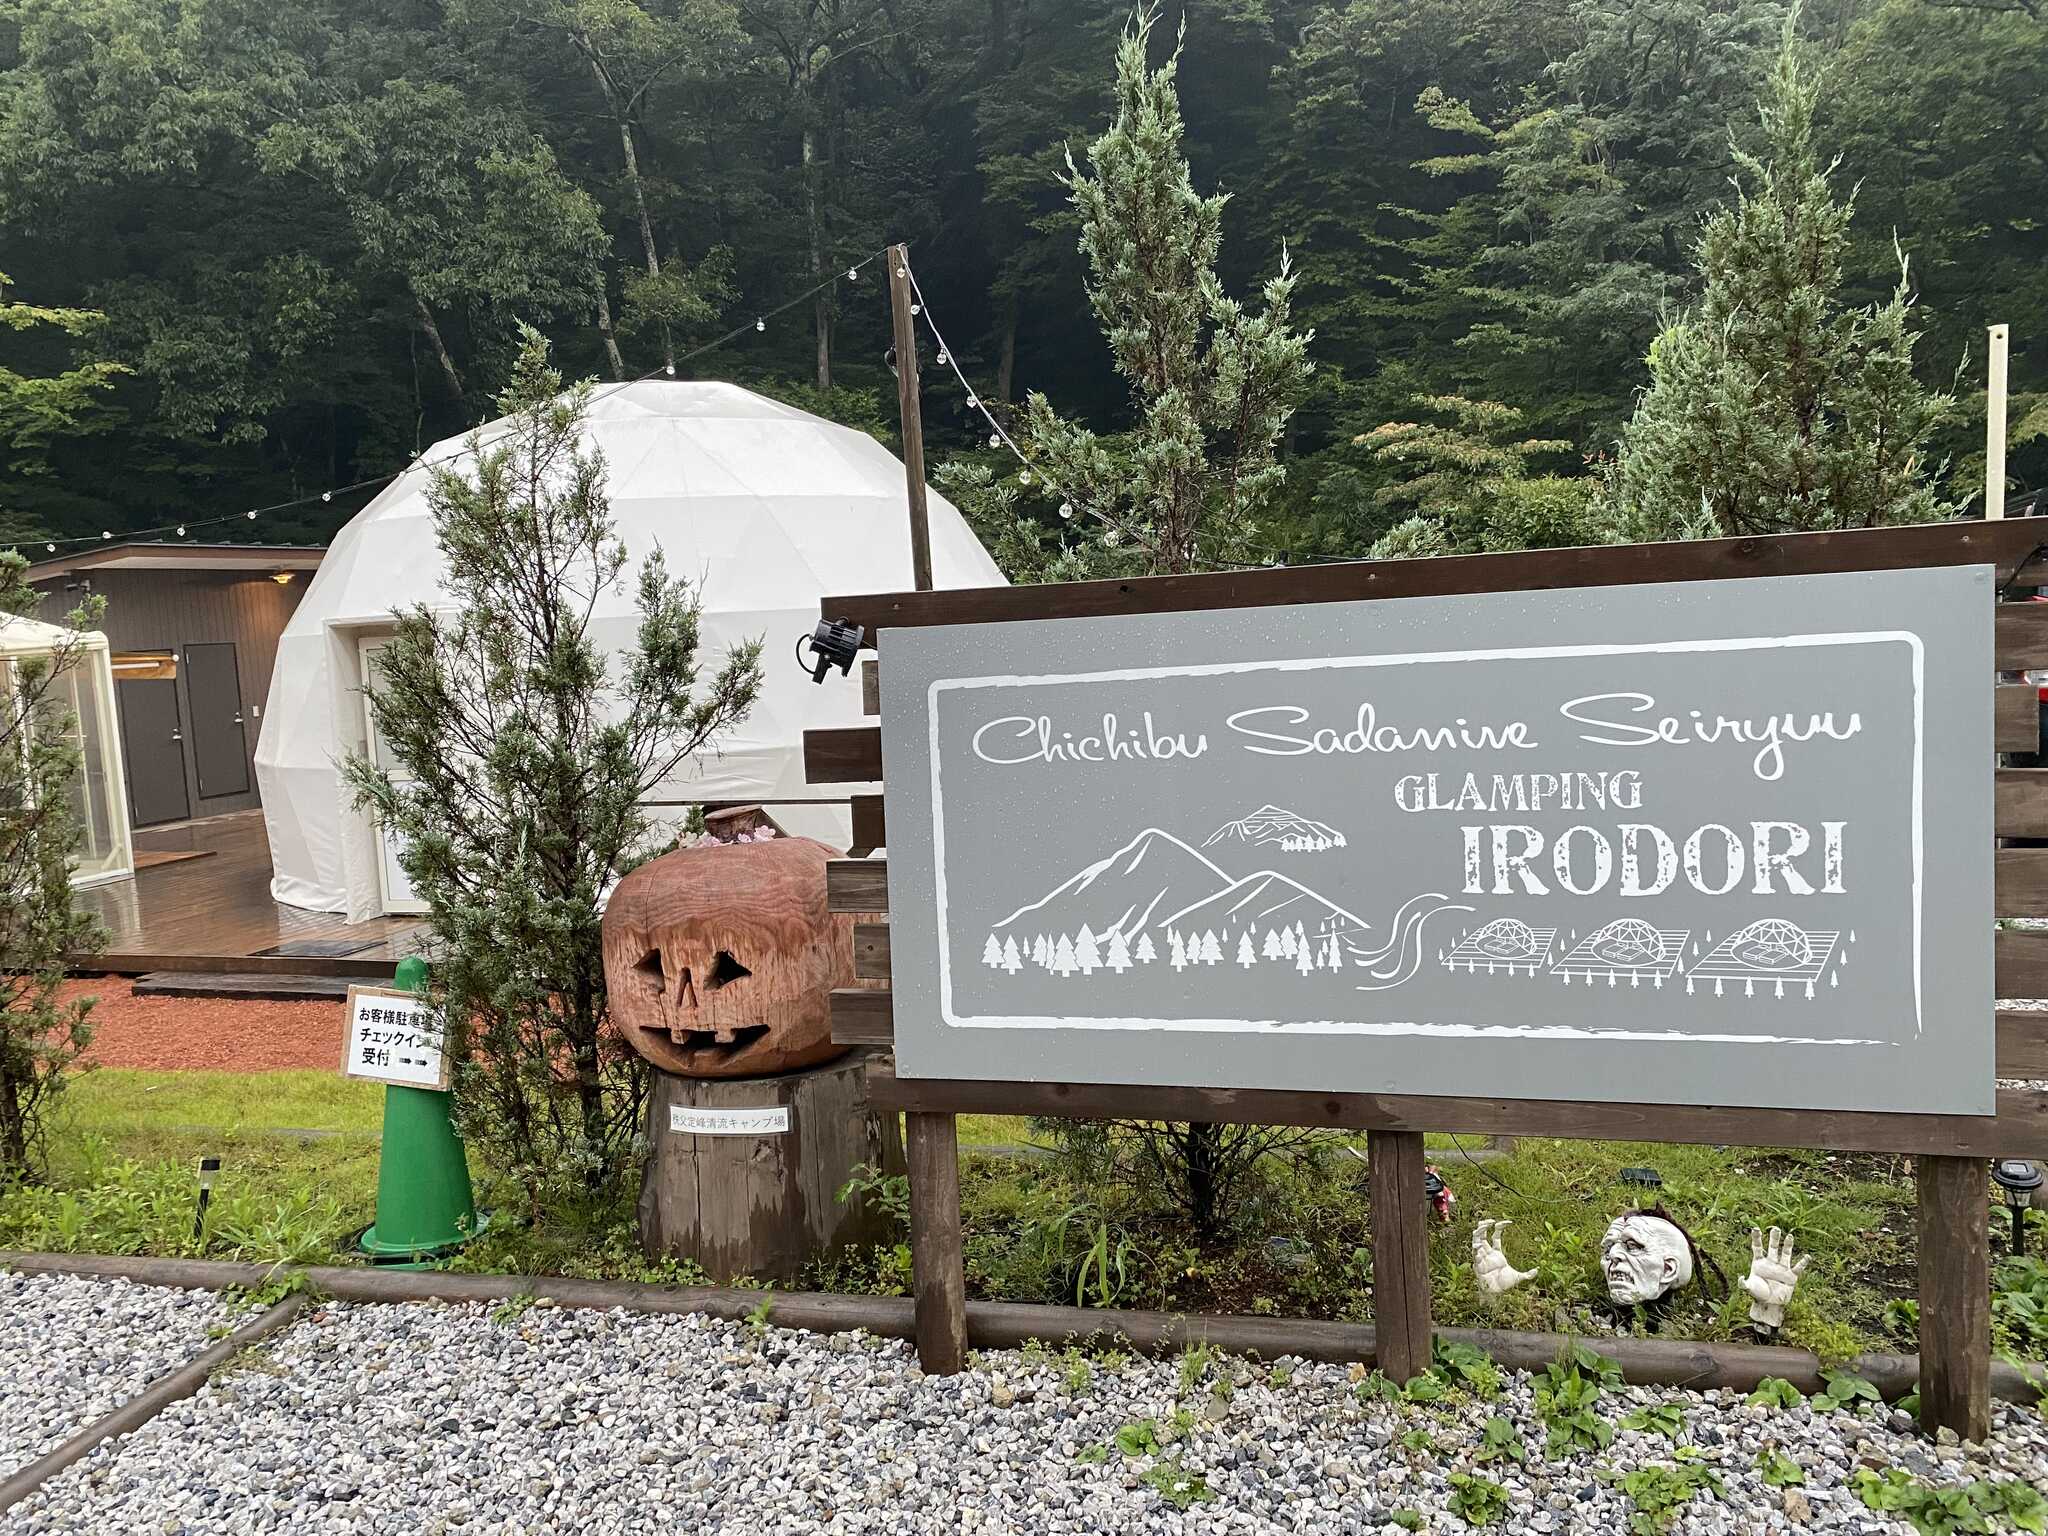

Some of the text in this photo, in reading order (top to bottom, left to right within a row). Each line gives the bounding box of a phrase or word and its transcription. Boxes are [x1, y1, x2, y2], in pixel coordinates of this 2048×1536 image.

[972, 692, 1862, 781] Chichibu Sadamine Seiryuu
[1394, 770, 1643, 812] GLAMPING
[1460, 821, 1848, 896] IRODORI
[362, 1047, 390, 1066] 受付
